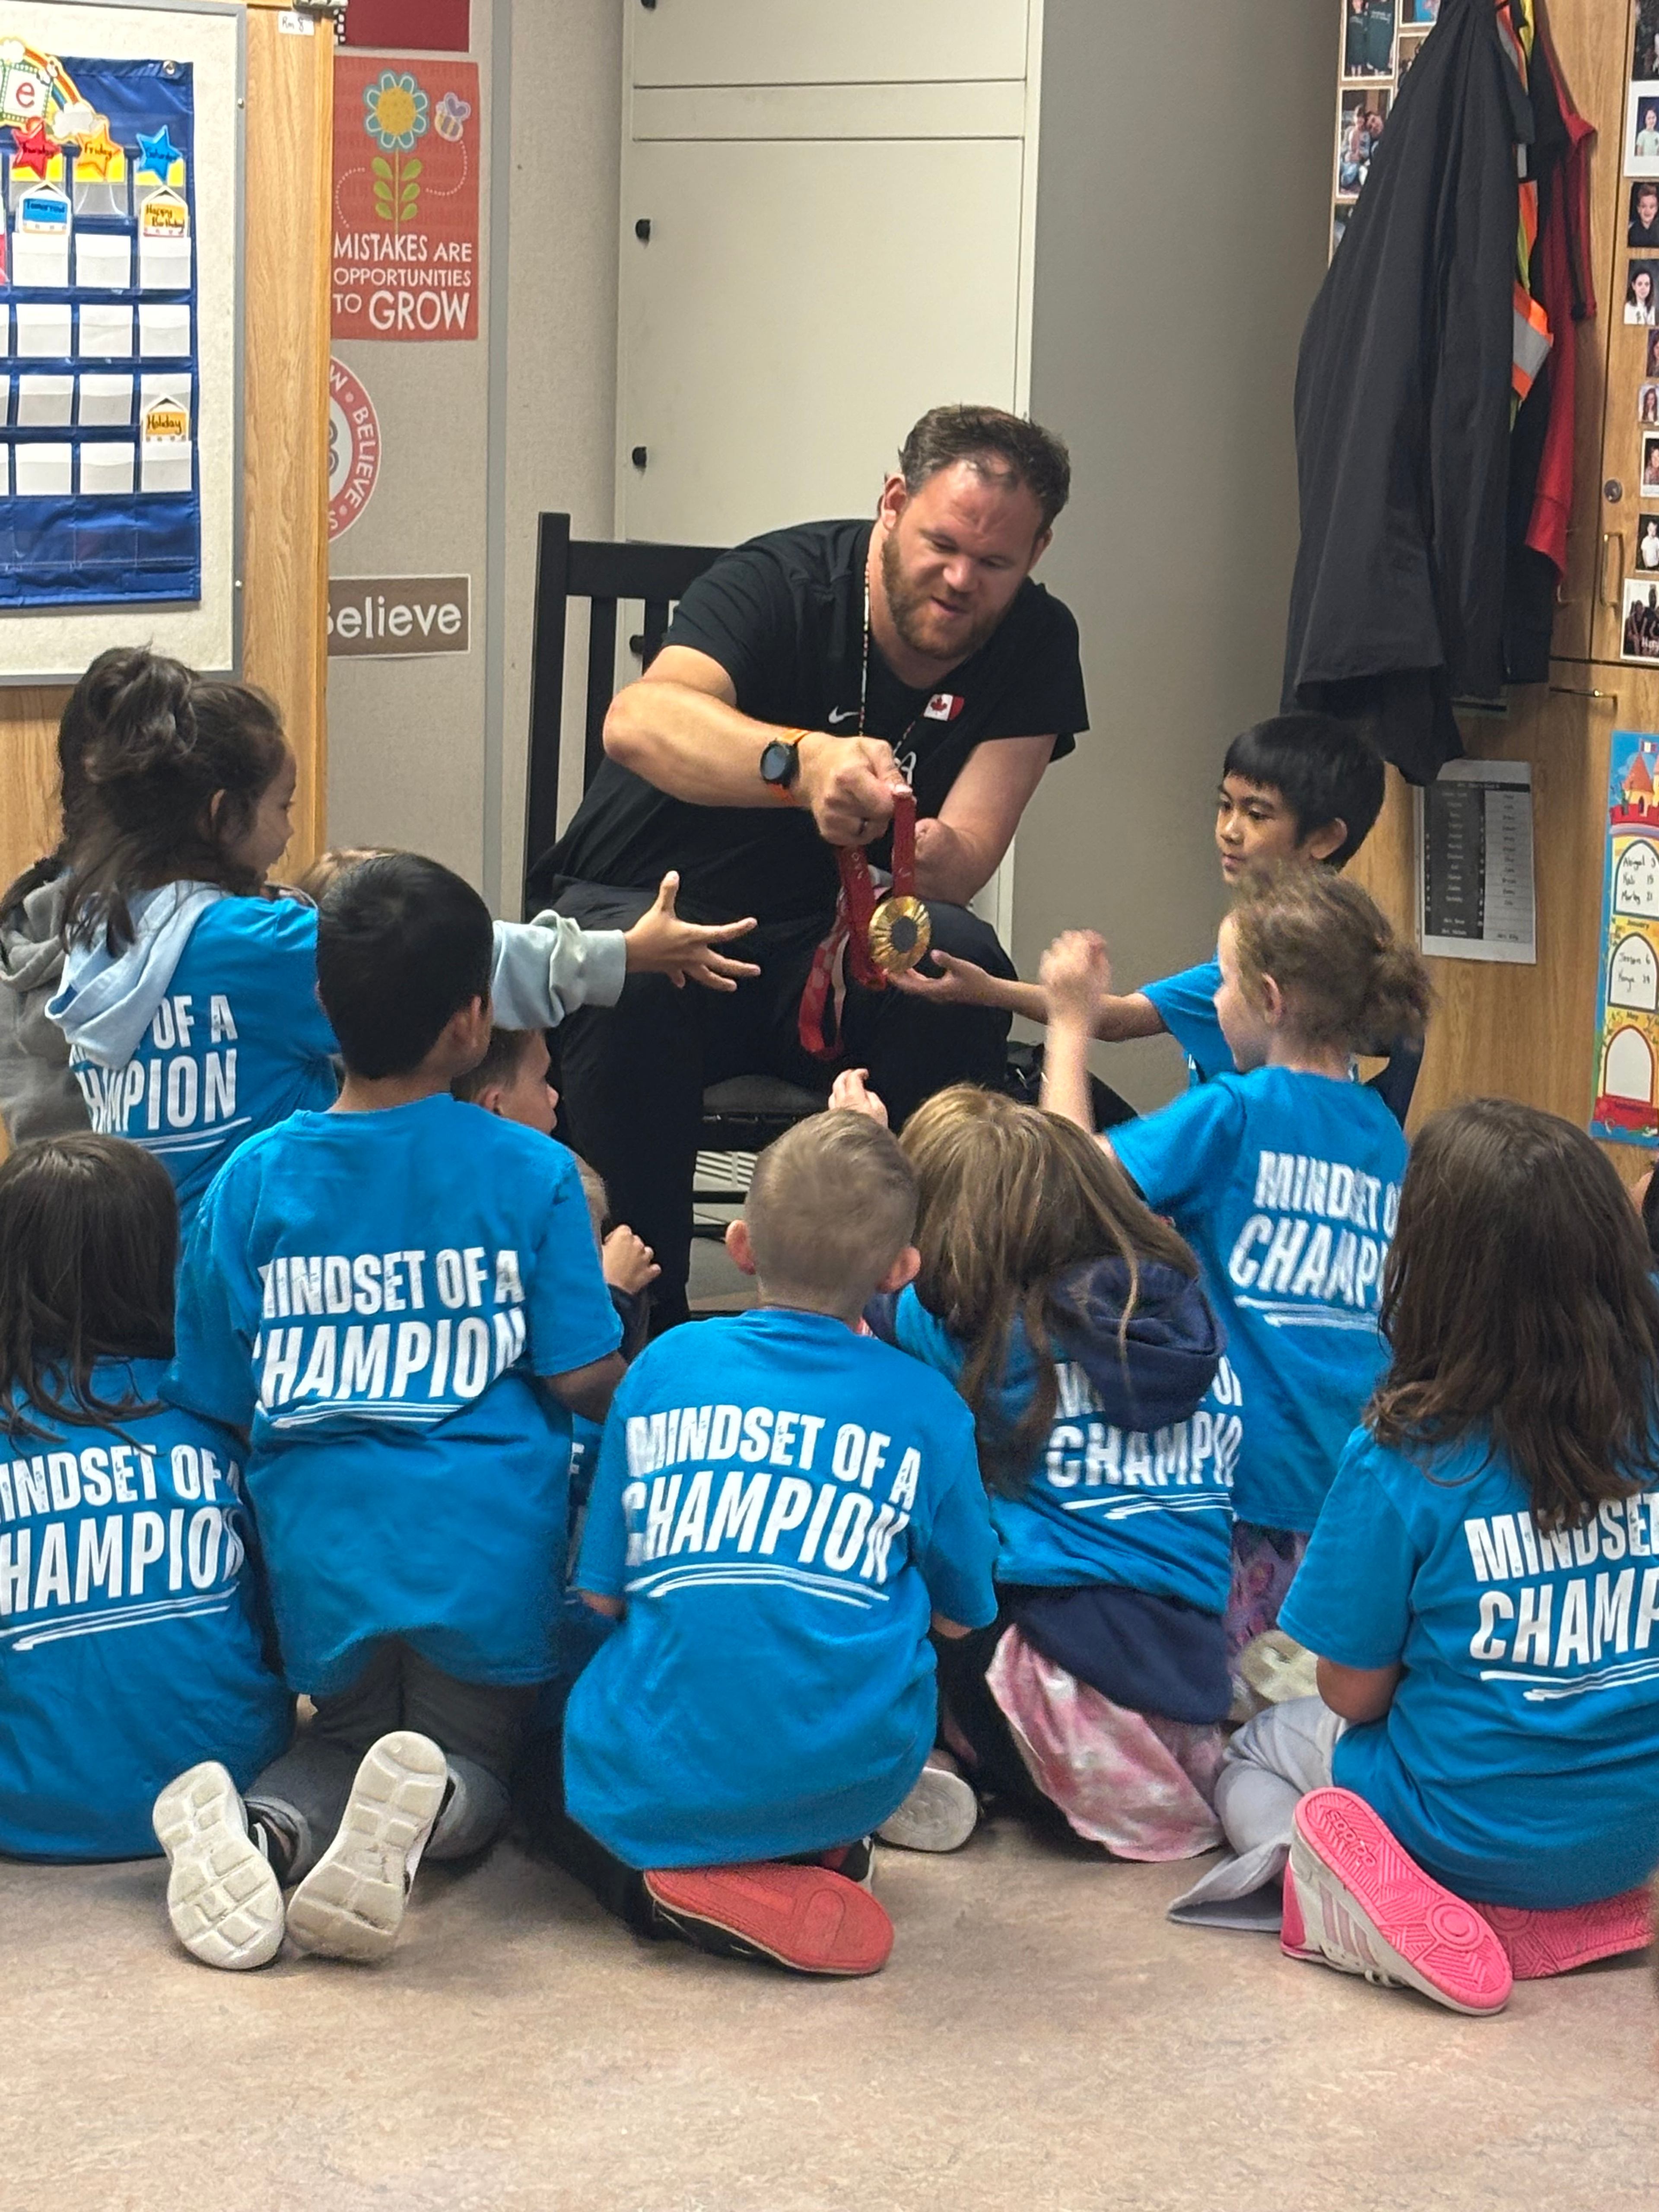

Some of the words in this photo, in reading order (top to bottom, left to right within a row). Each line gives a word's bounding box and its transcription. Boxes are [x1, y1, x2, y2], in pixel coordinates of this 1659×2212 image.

[282, 16, 295, 29] Rm
[297, 16, 304, 33] 8
[16, 82, 35, 108] e
[84, 140, 112, 160] Friday
[146, 204, 172, 218] Happy
[334, 232, 428, 261] MISTAKES
[433, 242, 472, 262] ARE
[334, 267, 471, 287] OPPORTUNITIES
[333, 292, 362, 314] TO
[369, 289, 470, 331] GROW
[147, 413, 182, 435] Holiday
[344, 405, 376, 509] BELIEVE
[153, 995, 195, 1050] OF
[210, 995, 238, 1043] A
[436, 1247, 488, 1309] OF
[494, 1249, 525, 1304] A
[252, 1306, 526, 1408] HAMPION
[0, 1444, 157, 1522] INDSET
[171, 1444, 222, 1502] OF
[625, 1404, 826, 1478] MINDSET
[832, 1423, 891, 1491] OF
[889, 1446, 921, 1511] A
[621, 1470, 910, 1585] CHAMPION
[0, 1506, 245, 1616] HAMPIO
[1470, 1566, 1659, 1668] CHAMP
[1325, 1809, 1377, 1867] adidas
